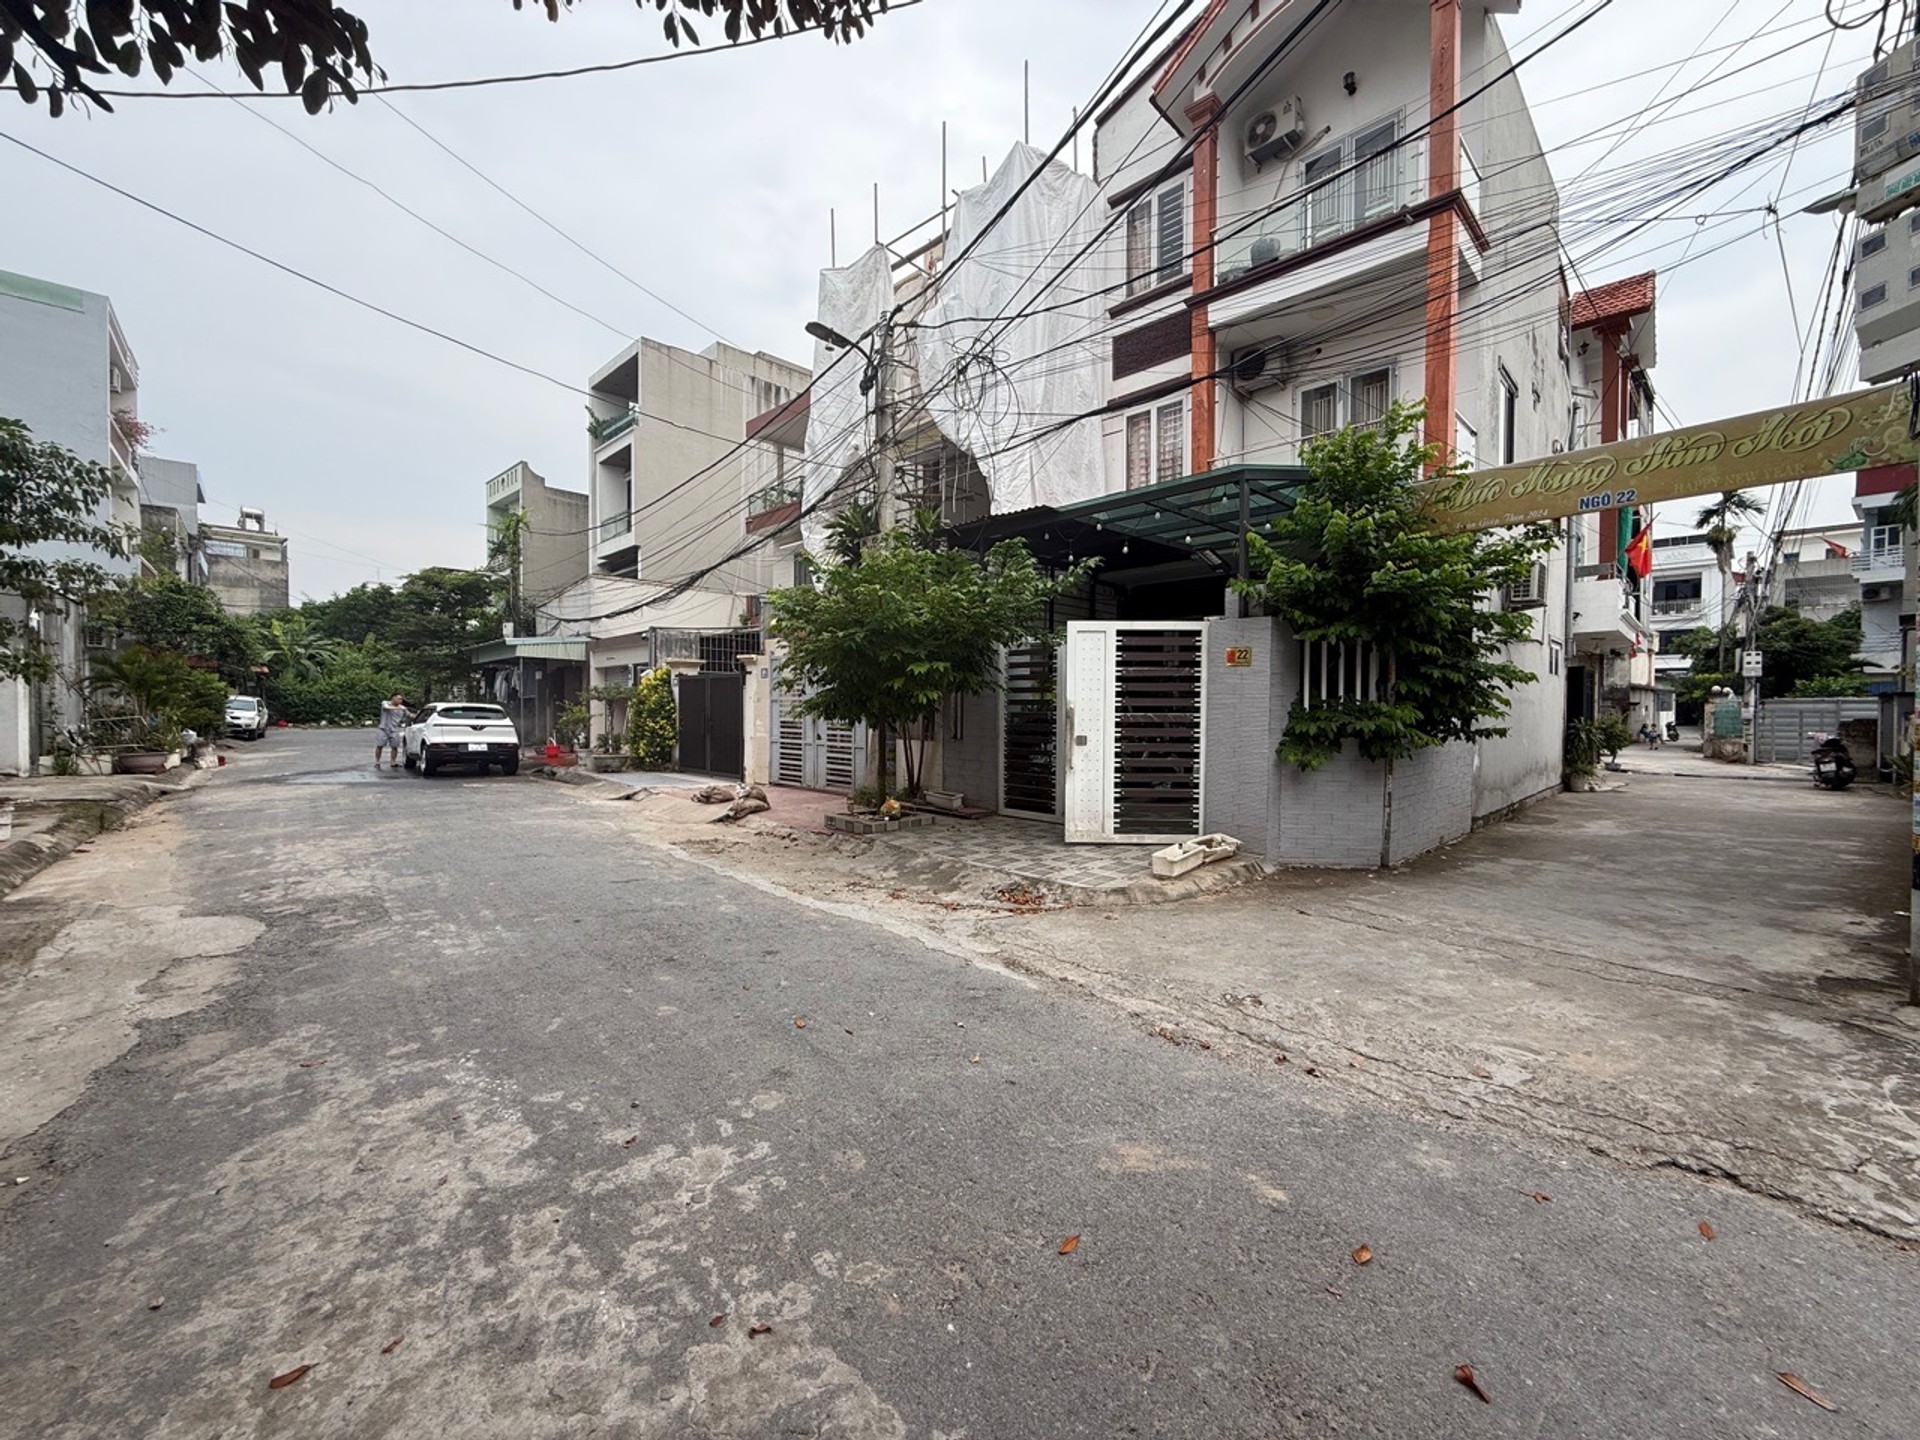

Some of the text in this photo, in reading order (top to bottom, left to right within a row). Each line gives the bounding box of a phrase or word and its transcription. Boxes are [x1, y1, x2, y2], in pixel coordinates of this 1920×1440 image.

[1674, 462, 1806, 493] HAPPY NEW YEAR
[1616, 489, 1637, 504] 22
[1237, 649, 1249, 659] 22
